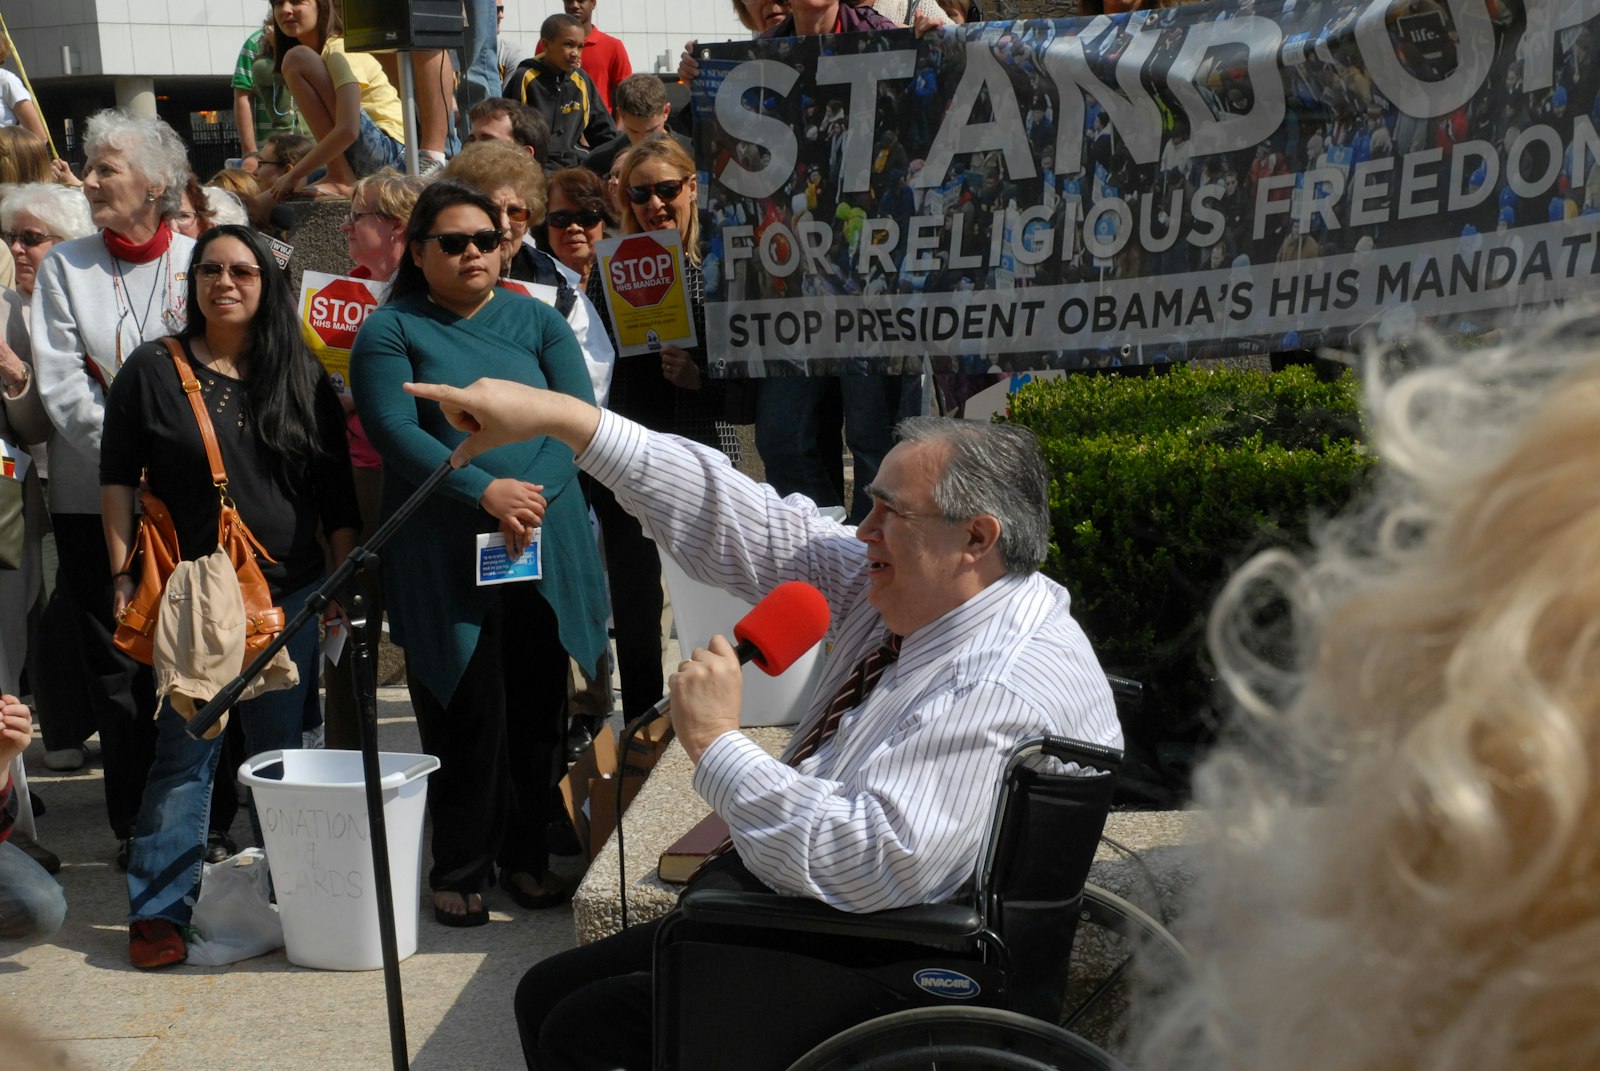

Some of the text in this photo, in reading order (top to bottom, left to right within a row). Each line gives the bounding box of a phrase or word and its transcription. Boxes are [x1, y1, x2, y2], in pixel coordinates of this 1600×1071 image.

[714, 12, 1286, 199] STAND
[722, 221, 834, 281] FOR
[858, 183, 1227, 275] RELIGIOUS
[611, 254, 672, 286] STOP
[616, 276, 672, 293] HHS MANDATE
[729, 310, 823, 348] STOP
[835, 301, 1045, 343] PRESIDENT
[1057, 281, 1255, 335] OBAMA'S
[1268, 269, 1361, 317] HHS
[312, 318, 359, 333] HHS MAND
[280, 867, 363, 899] CARDS
[921, 976, 971, 990] INVACARE
